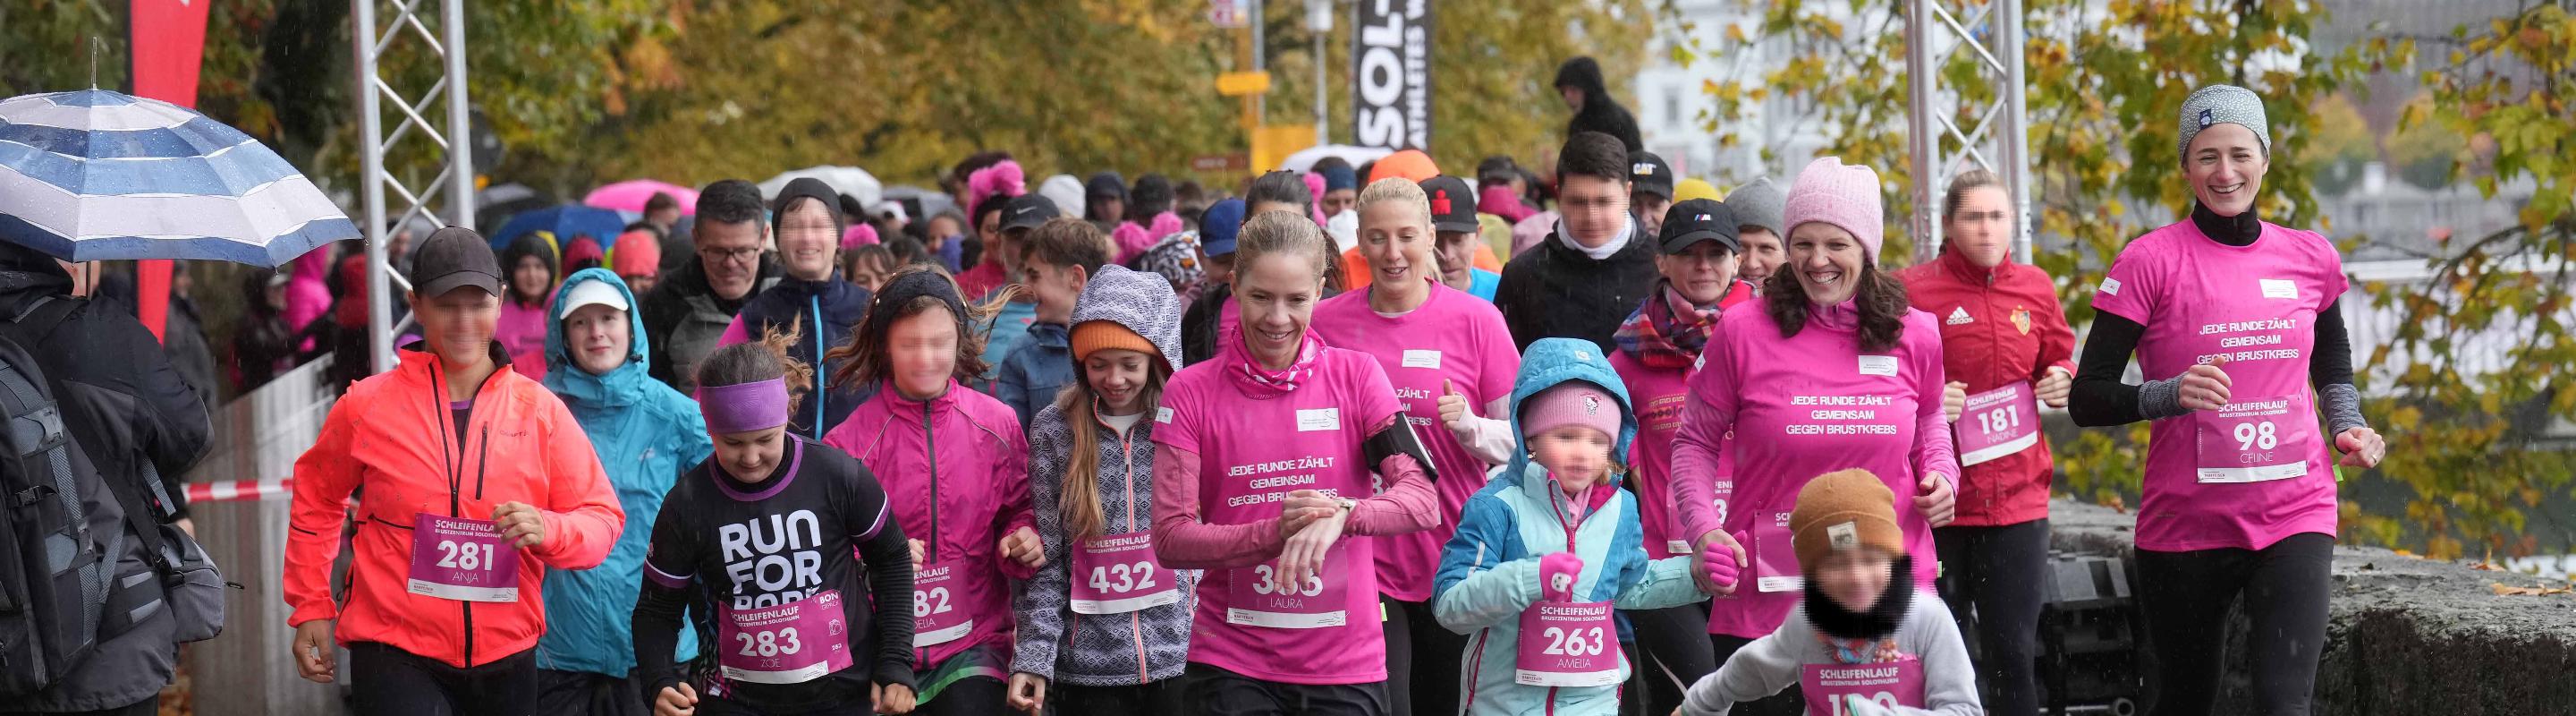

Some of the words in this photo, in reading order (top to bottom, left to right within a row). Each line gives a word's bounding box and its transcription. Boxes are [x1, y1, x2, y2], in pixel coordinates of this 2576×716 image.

[1404, 25, 1427, 150] ATHLETES
[1633, 163, 1654, 175] CAT
[1946, 316, 1974, 325] adidas
[2199, 323, 2227, 336] JEDE
[2229, 320, 2266, 332] RUNDE
[2267, 318, 2296, 330] ZÄHLT
[2220, 335, 2282, 348] GEMEINSAM
[2236, 349, 2300, 362] BRUSTKREBS
[1397, 387, 1431, 400] ZÄHLT
[1791, 396, 1818, 405] JEDE
[1819, 396, 1857, 405] RUNDE
[1858, 394, 1892, 405] ZÄHLT
[1810, 410, 1875, 420] GEMEINSAM
[1978, 405, 2019, 435] 181
[1785, 424, 1825, 435] GEGEN
[1826, 424, 1897, 435] BRUSTKREBS
[2233, 421, 2277, 450] 98
[2240, 451, 2273, 464] CELINE
[1228, 465, 1255, 477] JEDE
[1257, 459, 1296, 473] RUNDE
[1297, 456, 1335, 470] ZÄHLT
[1250, 474, 1316, 490] GEMEINSAM
[1228, 494, 1266, 507] GEGEN
[435, 519, 496, 533] SCHLEIFENLA
[719, 509, 822, 563] RUN
[436, 540, 494, 571] 281
[452, 573, 479, 584] ANJA
[725, 550, 822, 594] FOR
[1089, 560, 1156, 594] 432
[1252, 564, 1323, 597] 36
[819, 592, 839, 604] BON
[914, 586, 952, 618] 82
[1270, 598, 1303, 609] LAURA
[736, 626, 801, 657] 283
[1542, 626, 1604, 656] 263
[1556, 658, 1591, 669] AMELIA
[1820, 667, 1898, 679] SCHLEIFENLAUF
